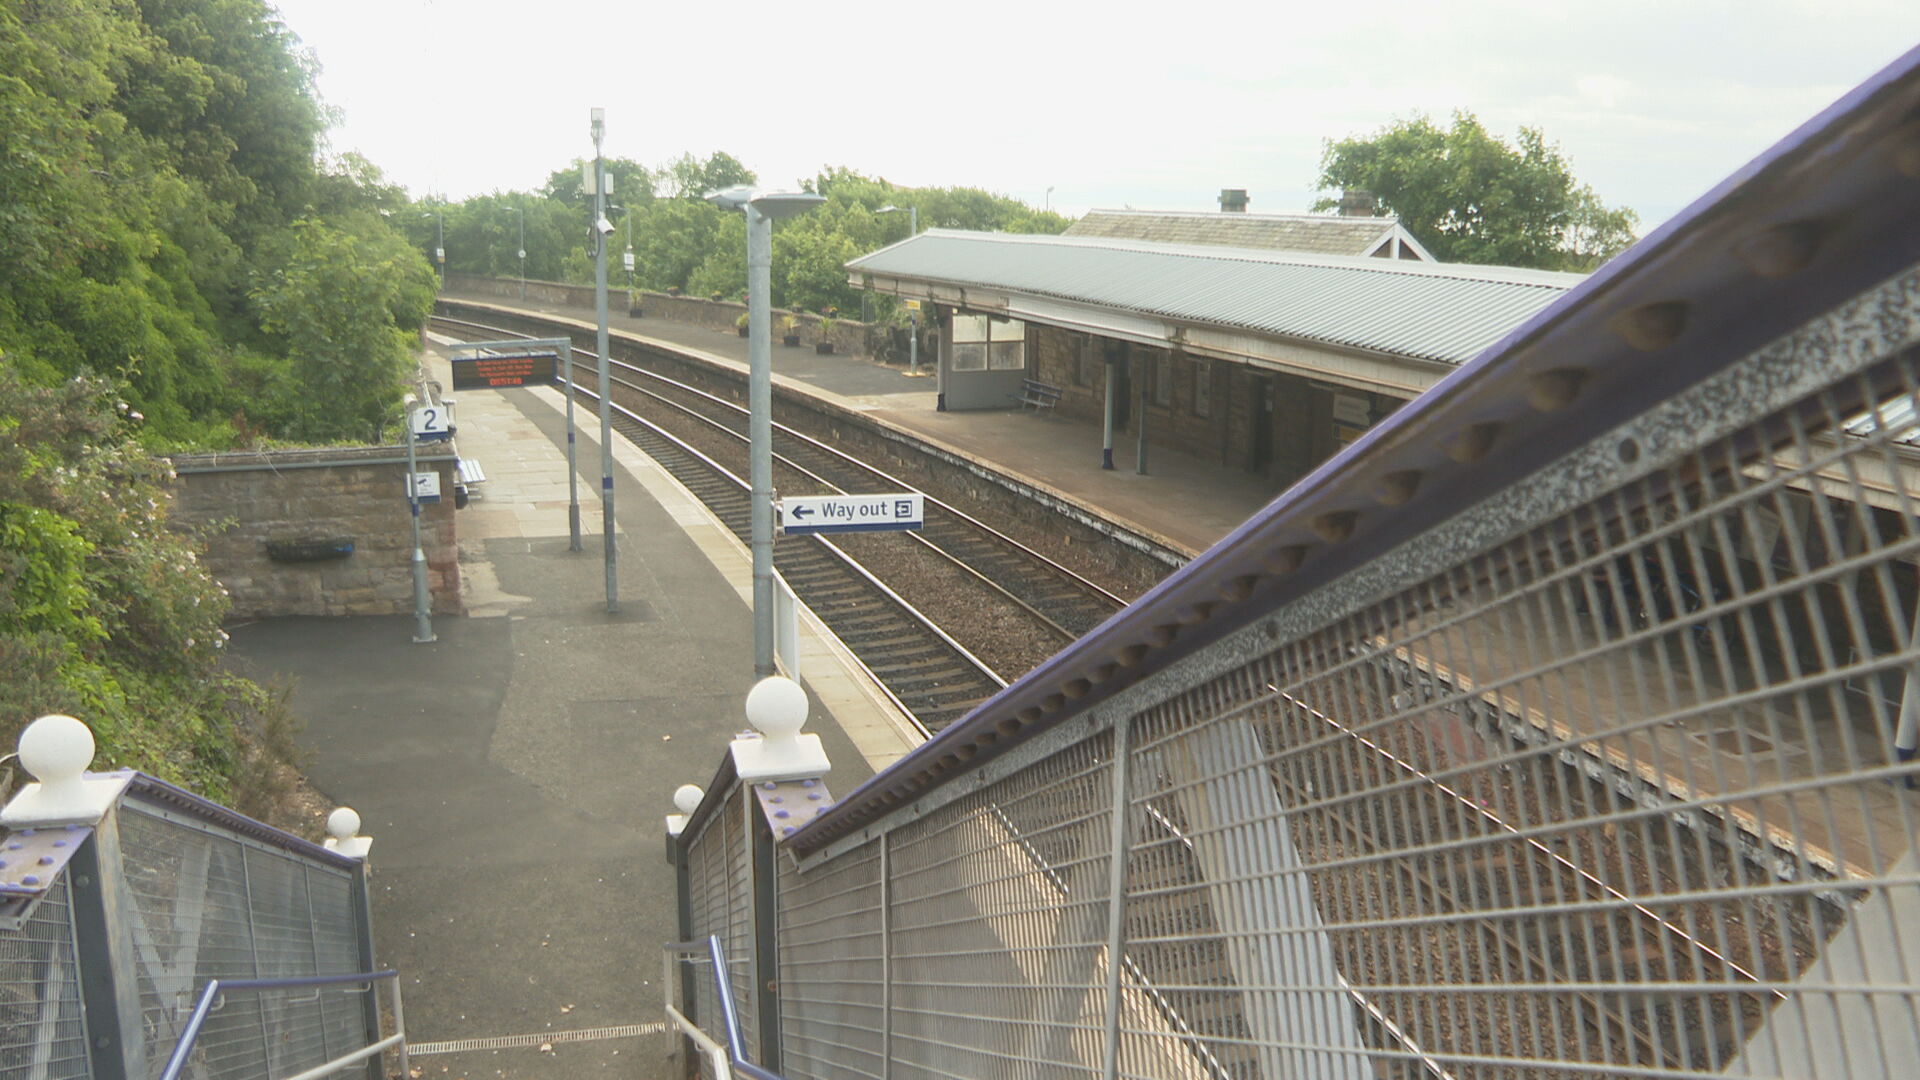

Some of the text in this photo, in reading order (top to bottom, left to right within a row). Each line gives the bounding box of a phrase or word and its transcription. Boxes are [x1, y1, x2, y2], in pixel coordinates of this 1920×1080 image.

[424, 409, 437, 431] 2
[821, 501, 888, 521] Way out
